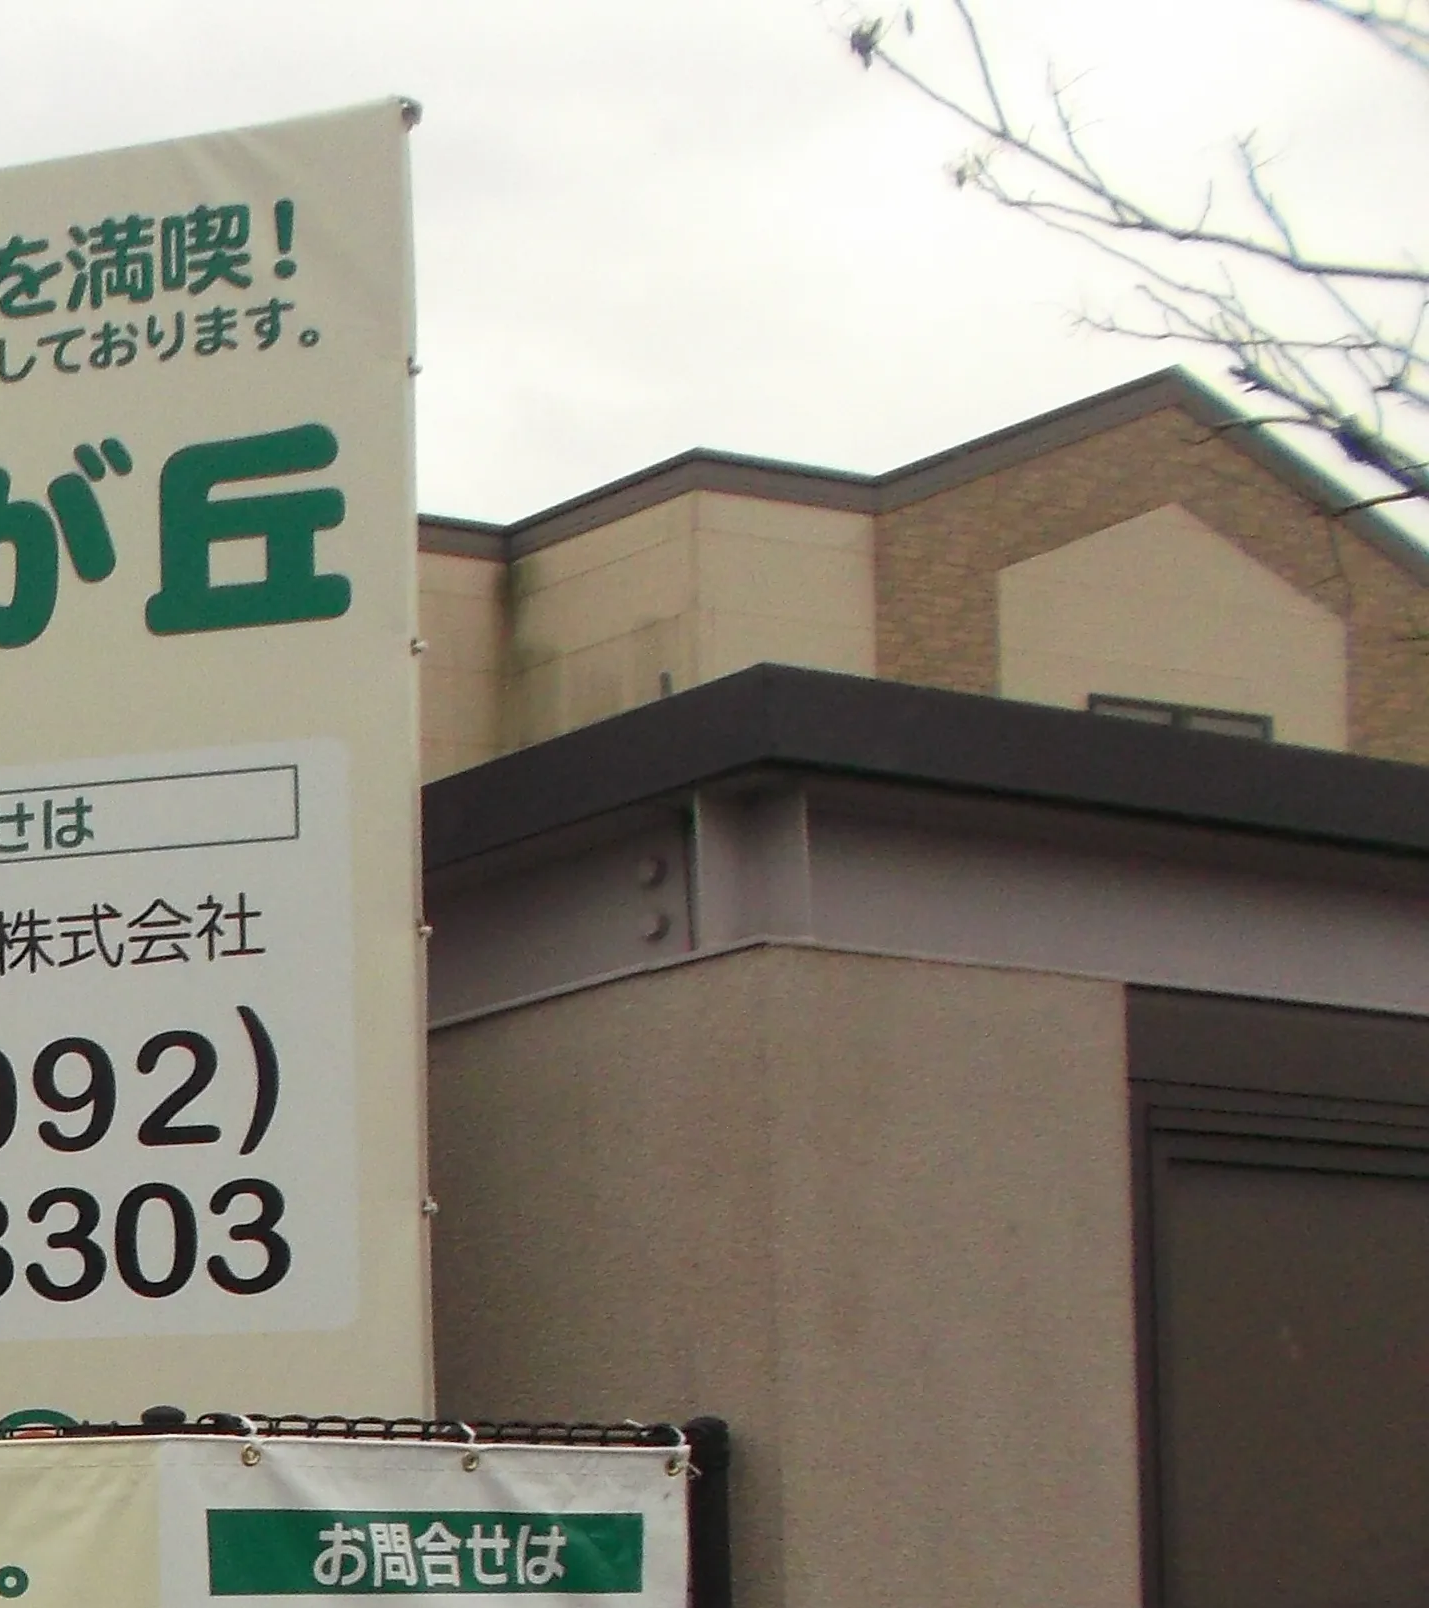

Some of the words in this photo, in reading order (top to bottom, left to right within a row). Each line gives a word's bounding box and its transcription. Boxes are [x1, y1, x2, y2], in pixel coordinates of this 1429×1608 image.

[313, 1521, 568, 1588] お問合せは
